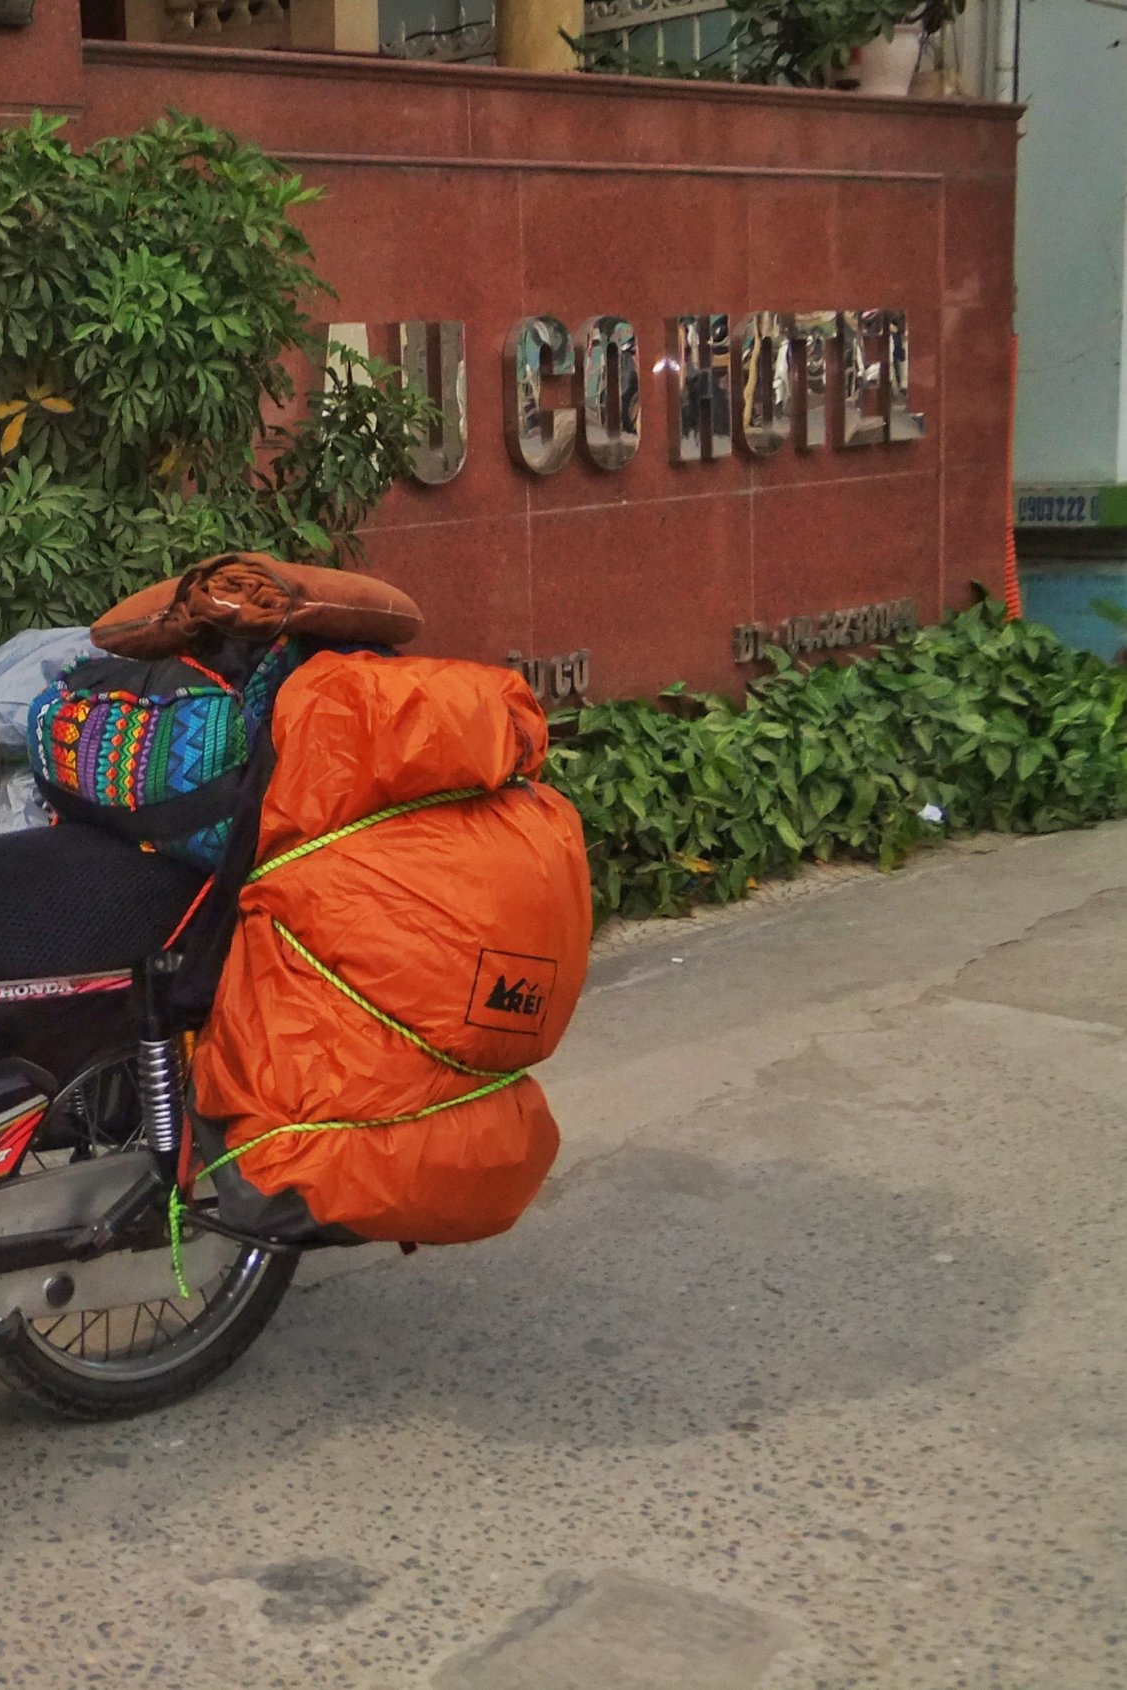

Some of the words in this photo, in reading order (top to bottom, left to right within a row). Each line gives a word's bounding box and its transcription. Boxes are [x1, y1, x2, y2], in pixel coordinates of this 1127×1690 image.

[508, 314, 642, 476] CO
[671, 309, 926, 465] HOTEL
[508, 992, 543, 1015] REI
